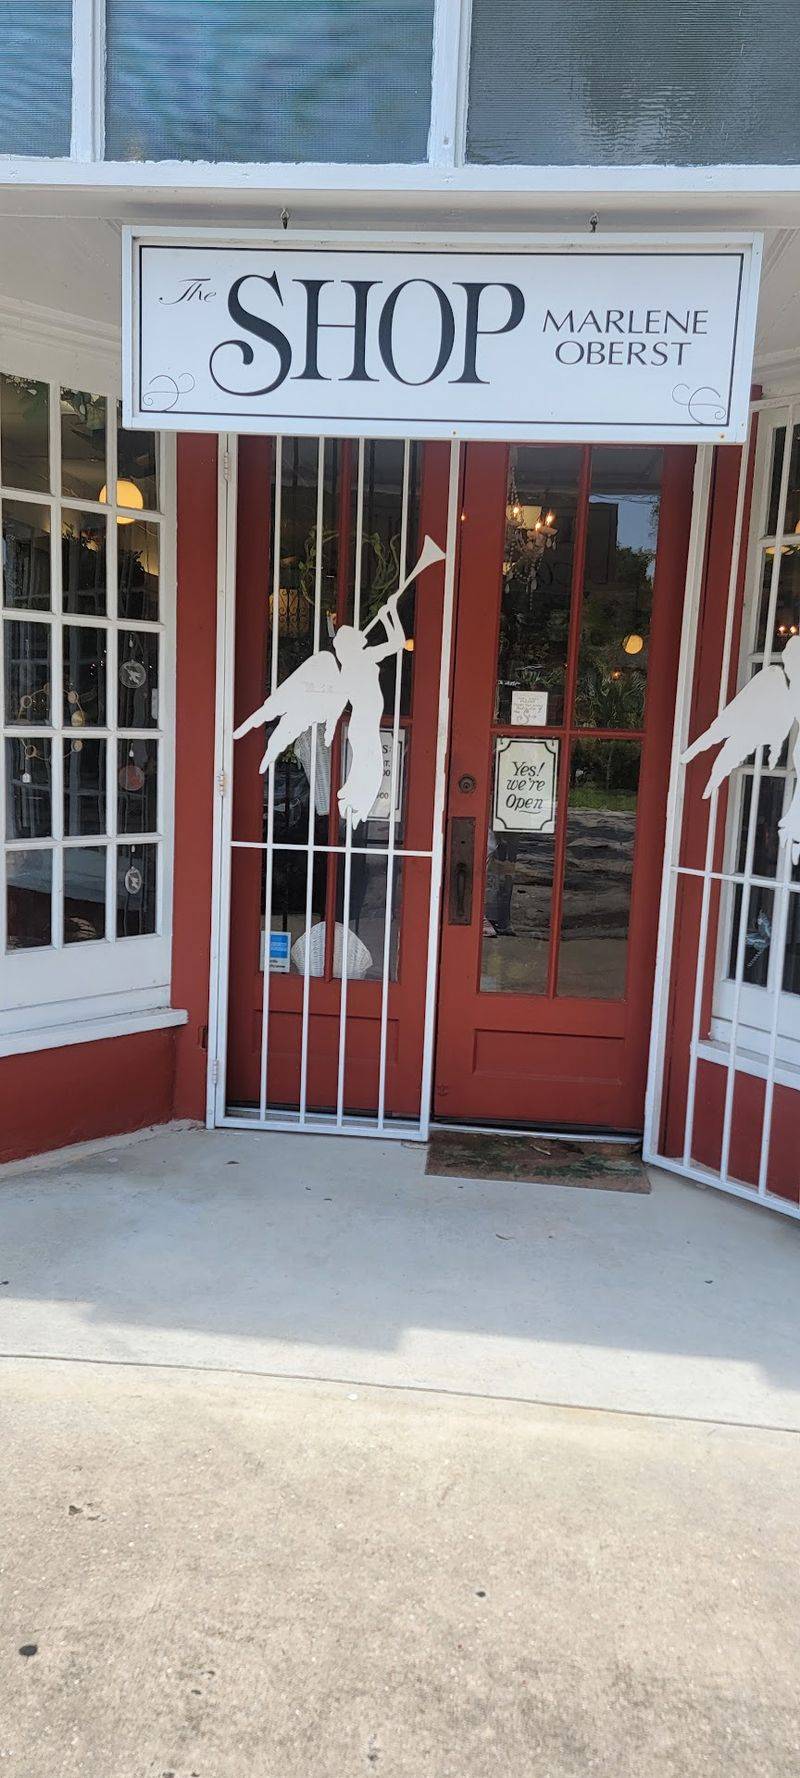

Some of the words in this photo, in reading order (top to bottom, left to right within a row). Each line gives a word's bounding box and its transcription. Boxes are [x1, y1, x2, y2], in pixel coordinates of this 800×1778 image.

[542, 309, 708, 335] MARLENE
[159, 278, 216, 305] The
[209, 270, 525, 397] SHOP
[556, 340, 692, 366] OBERST
[513, 761, 545, 777] Yes!
[506, 778, 545, 791] we're
[506, 794, 543, 811] Open
